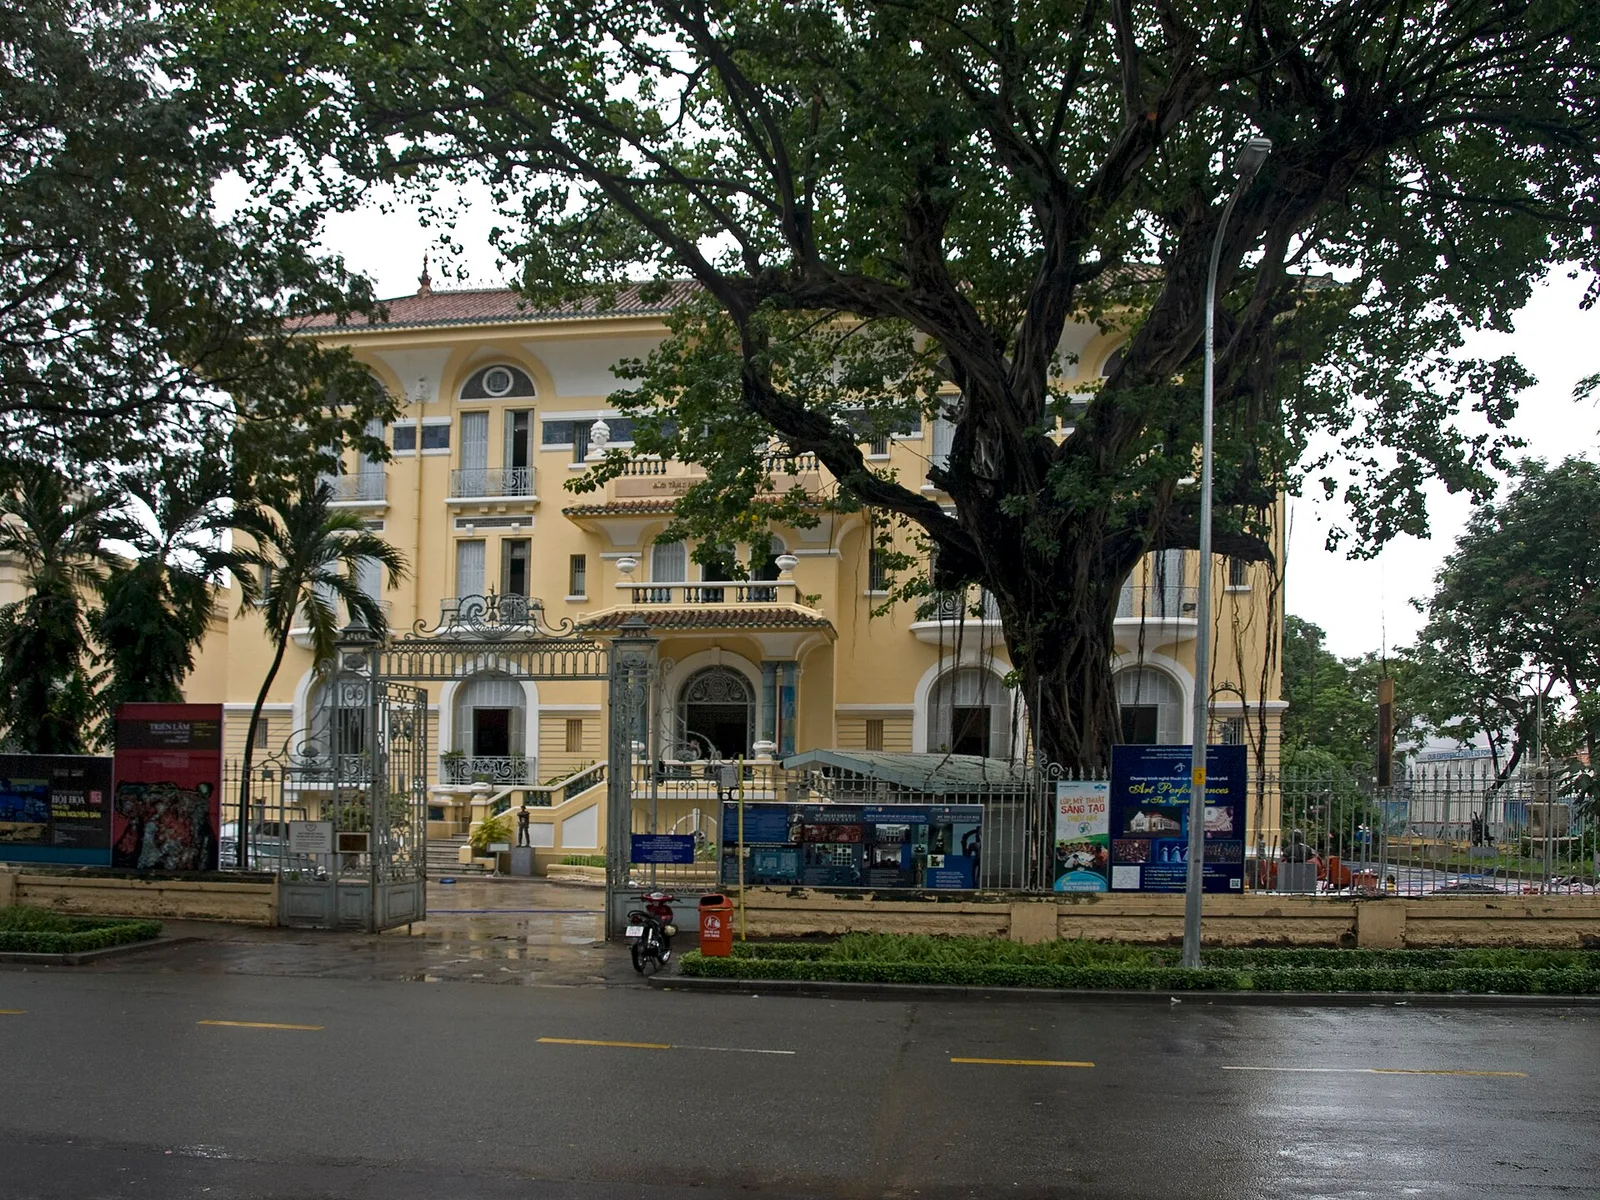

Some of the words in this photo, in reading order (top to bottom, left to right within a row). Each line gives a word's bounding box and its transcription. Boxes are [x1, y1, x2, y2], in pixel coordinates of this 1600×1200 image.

[1128, 782, 1155, 794] Art
[1060, 803, 1085, 814] SÁNG
[1088, 803, 1105, 814] TẠO
